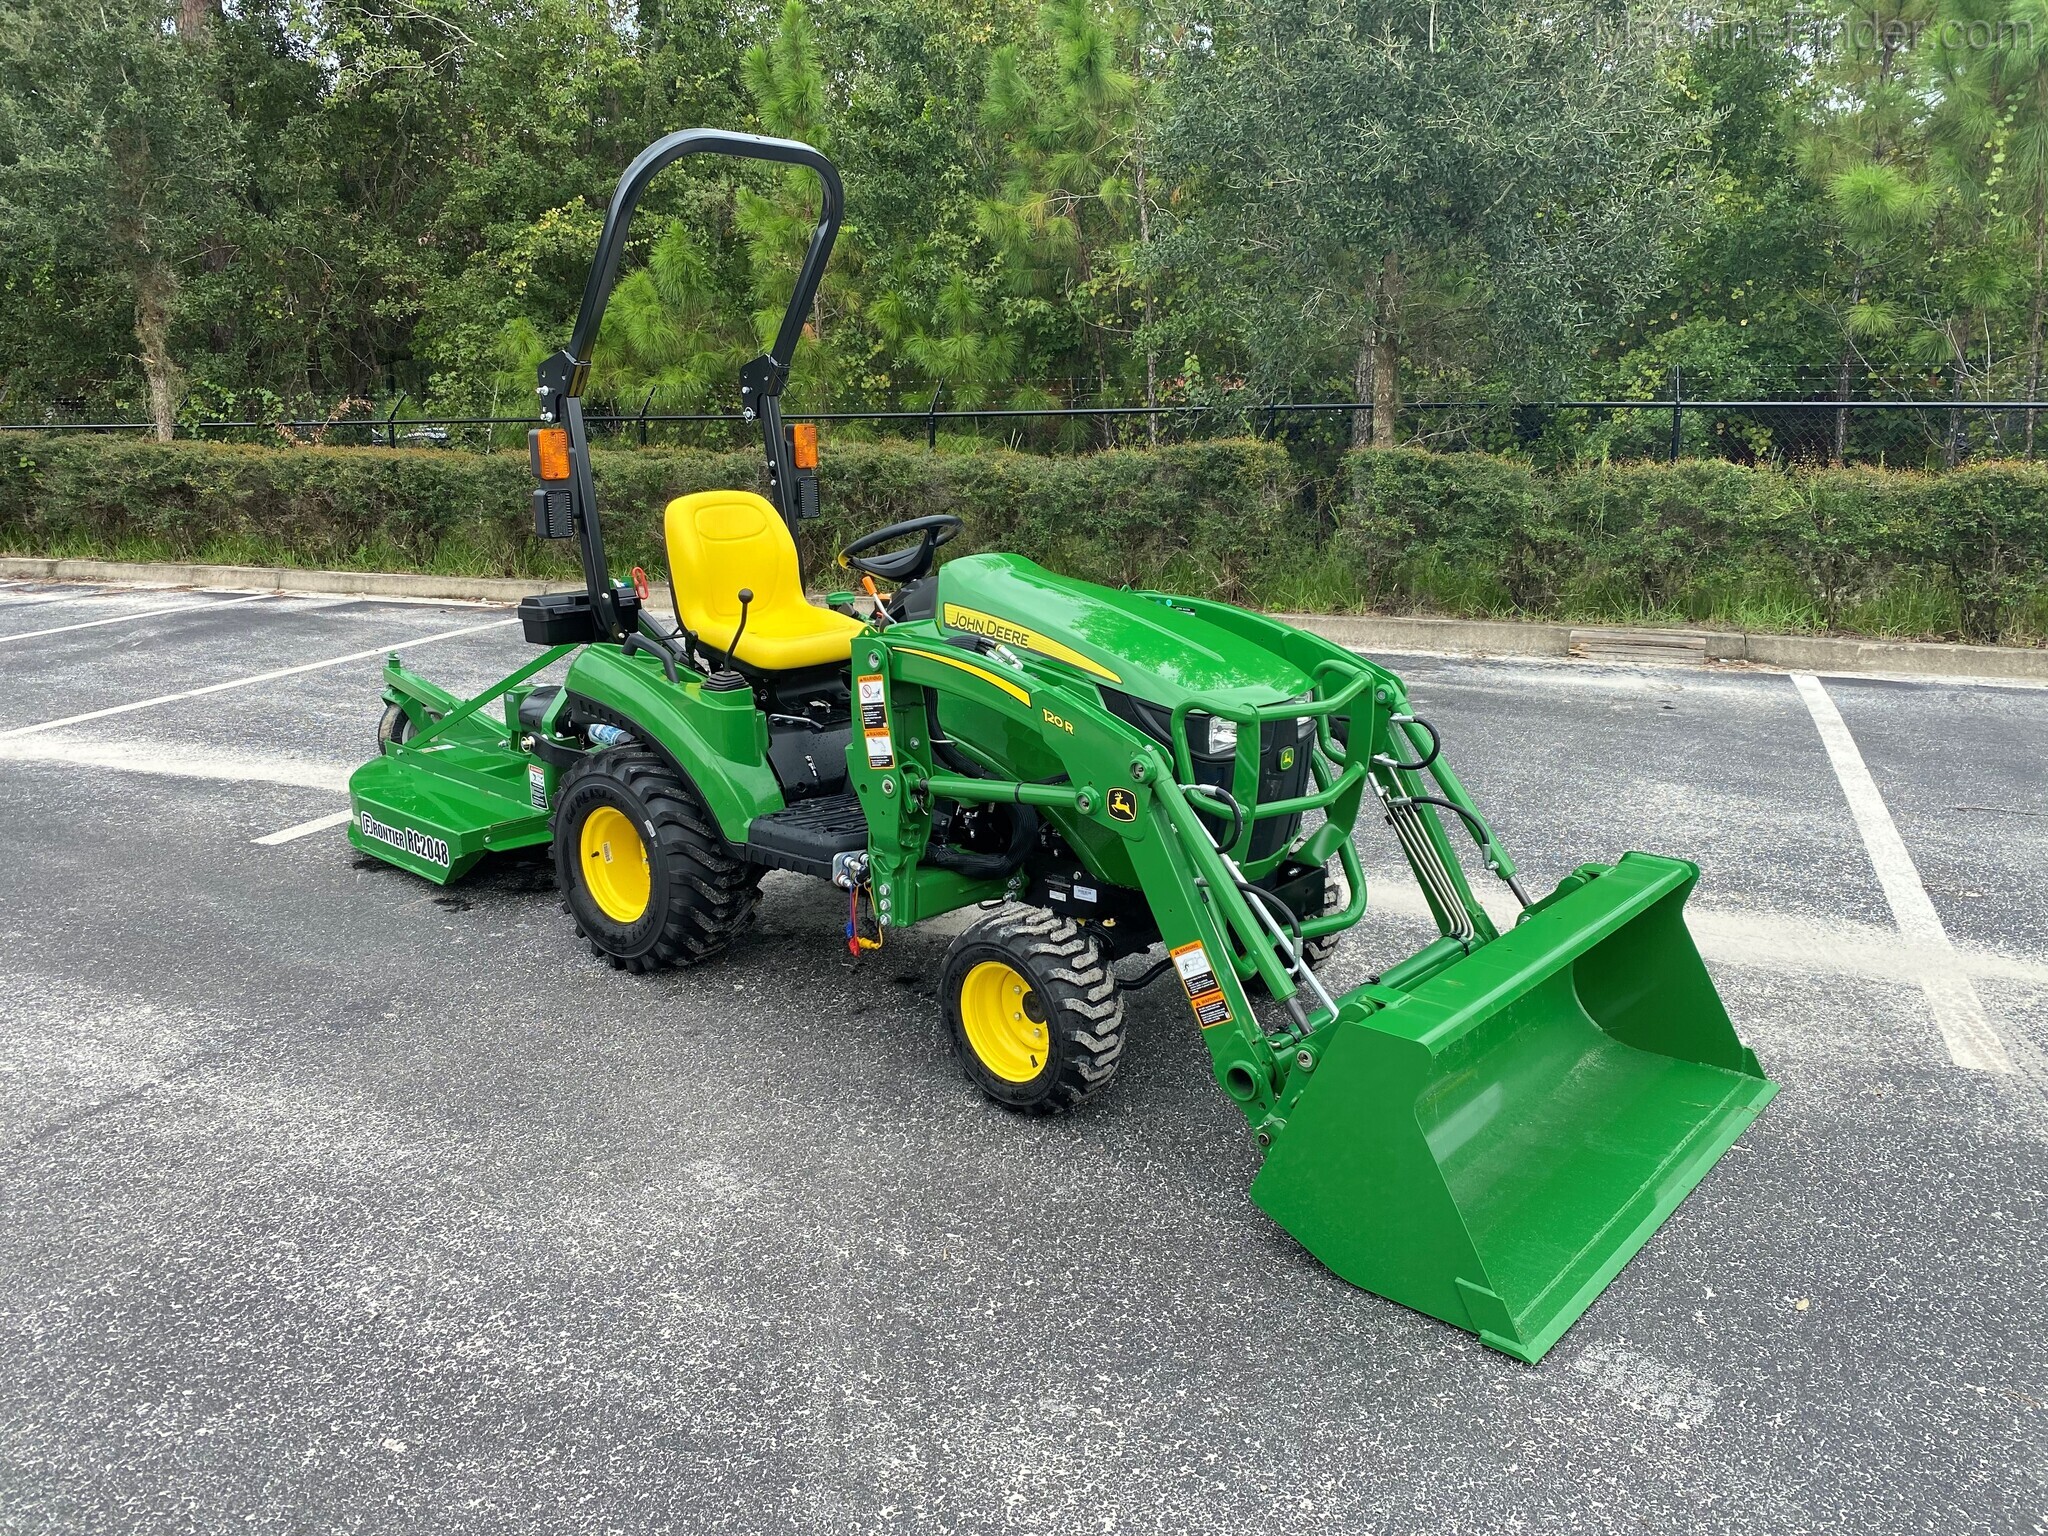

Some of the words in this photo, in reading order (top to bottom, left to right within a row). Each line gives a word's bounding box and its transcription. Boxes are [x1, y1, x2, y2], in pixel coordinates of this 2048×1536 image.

[951, 611, 985, 634] JOHN
[986, 620, 1030, 647] DEERE
[407, 829, 449, 865] RC2048
